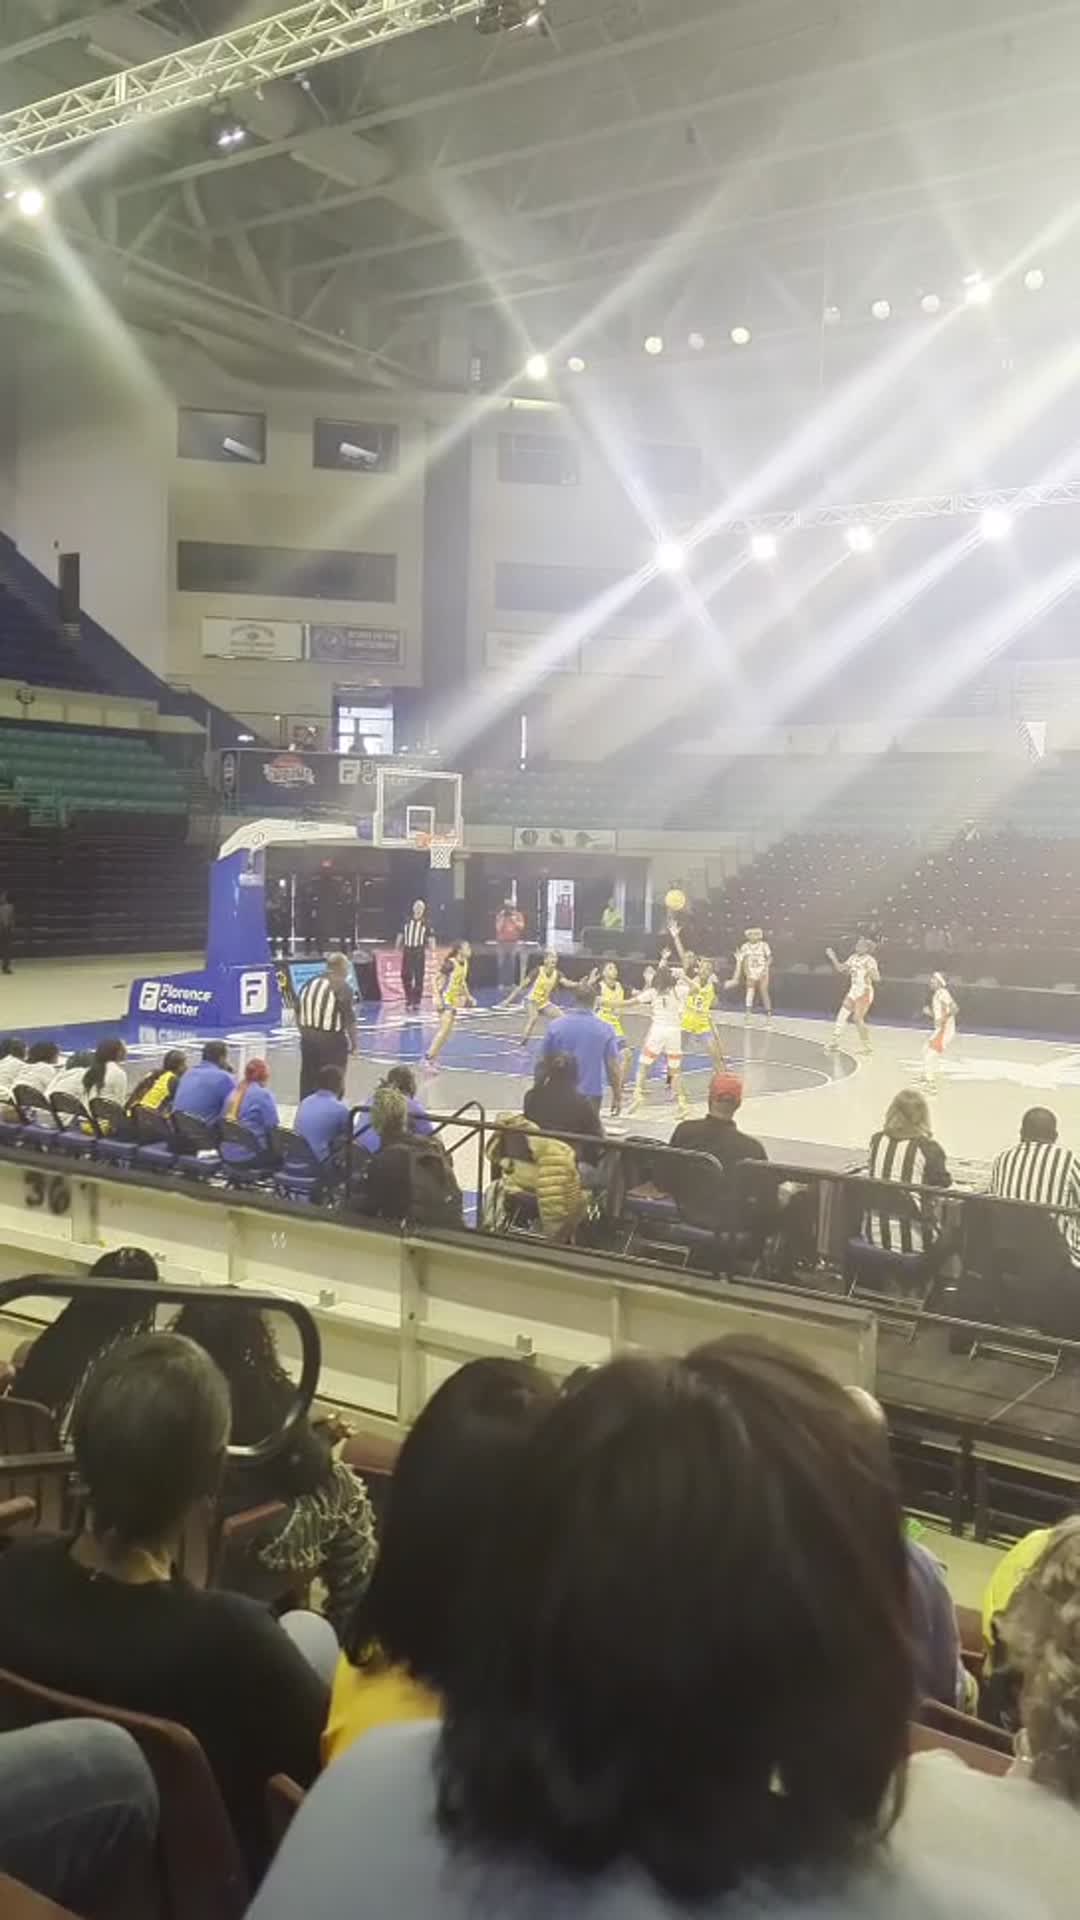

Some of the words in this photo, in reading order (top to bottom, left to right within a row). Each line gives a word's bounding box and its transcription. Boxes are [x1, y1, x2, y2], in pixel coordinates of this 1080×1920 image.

[160, 984, 213, 1002] Florence
[158, 1000, 200, 1016] Center
[25, 1171, 71, 1215] 36
